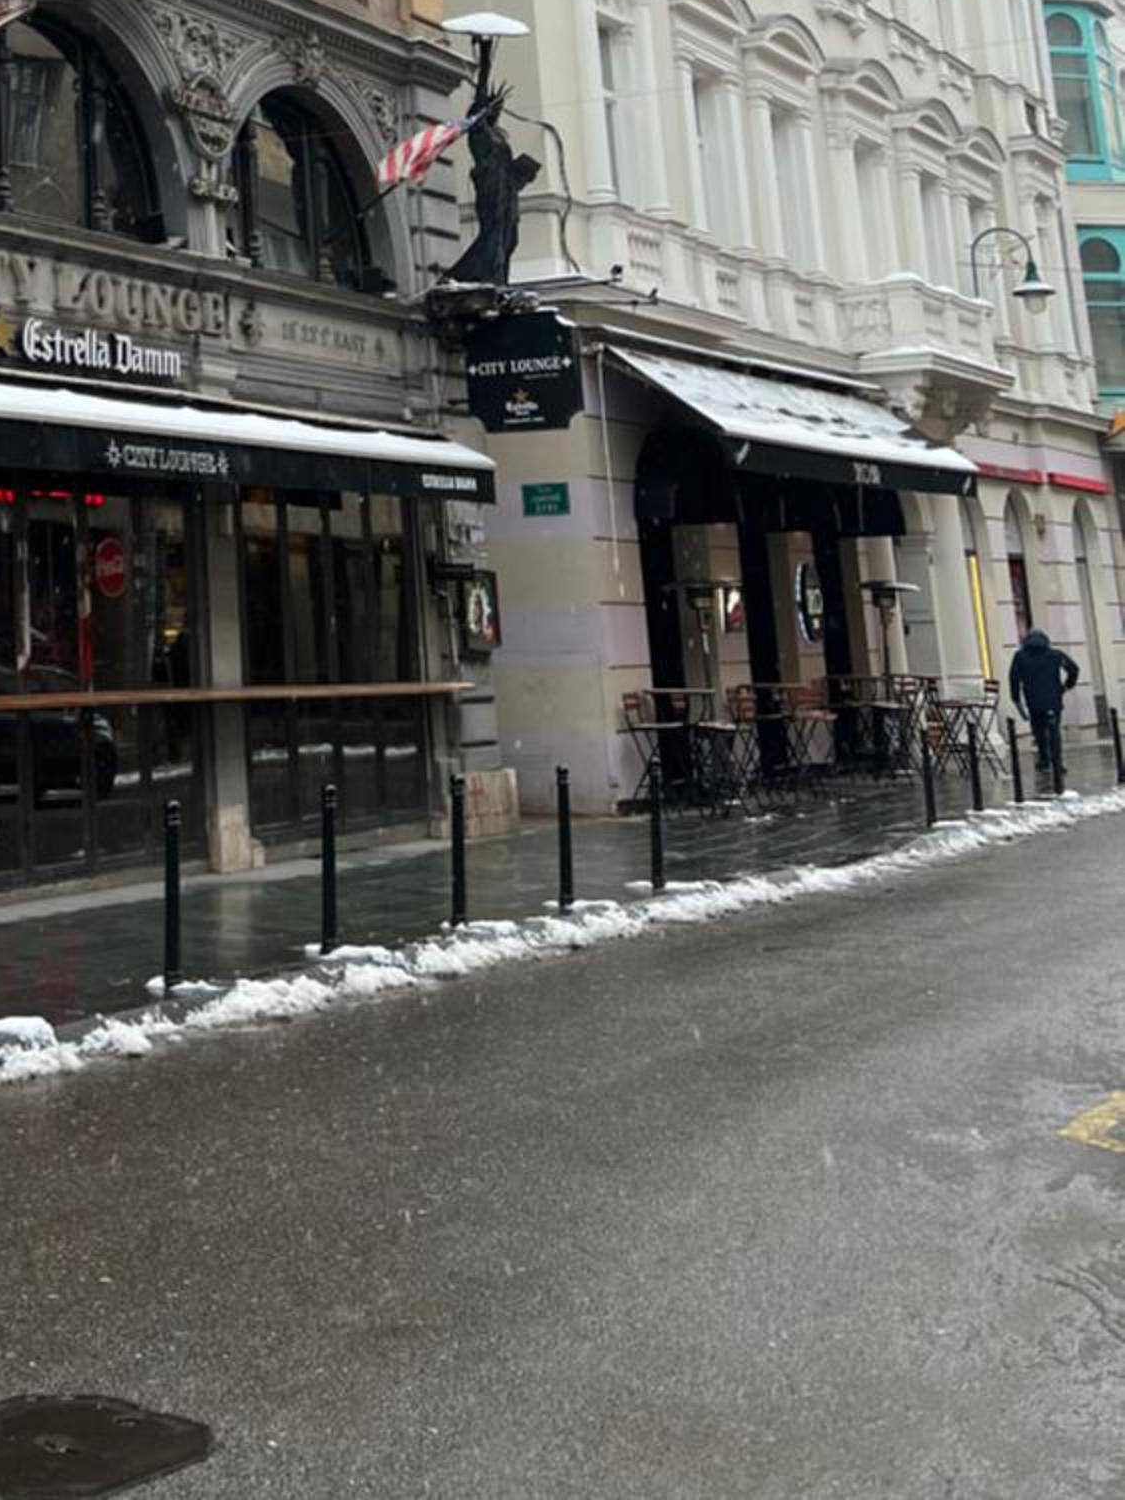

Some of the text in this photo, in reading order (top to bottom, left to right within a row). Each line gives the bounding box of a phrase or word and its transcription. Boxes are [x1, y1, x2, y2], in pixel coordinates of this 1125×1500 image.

[56, 262, 228, 336] LOUNGE
[23, 316, 182, 377] Estrella Damm
[478, 361, 506, 377] CITY
[510, 356, 562, 374] LOUNGE
